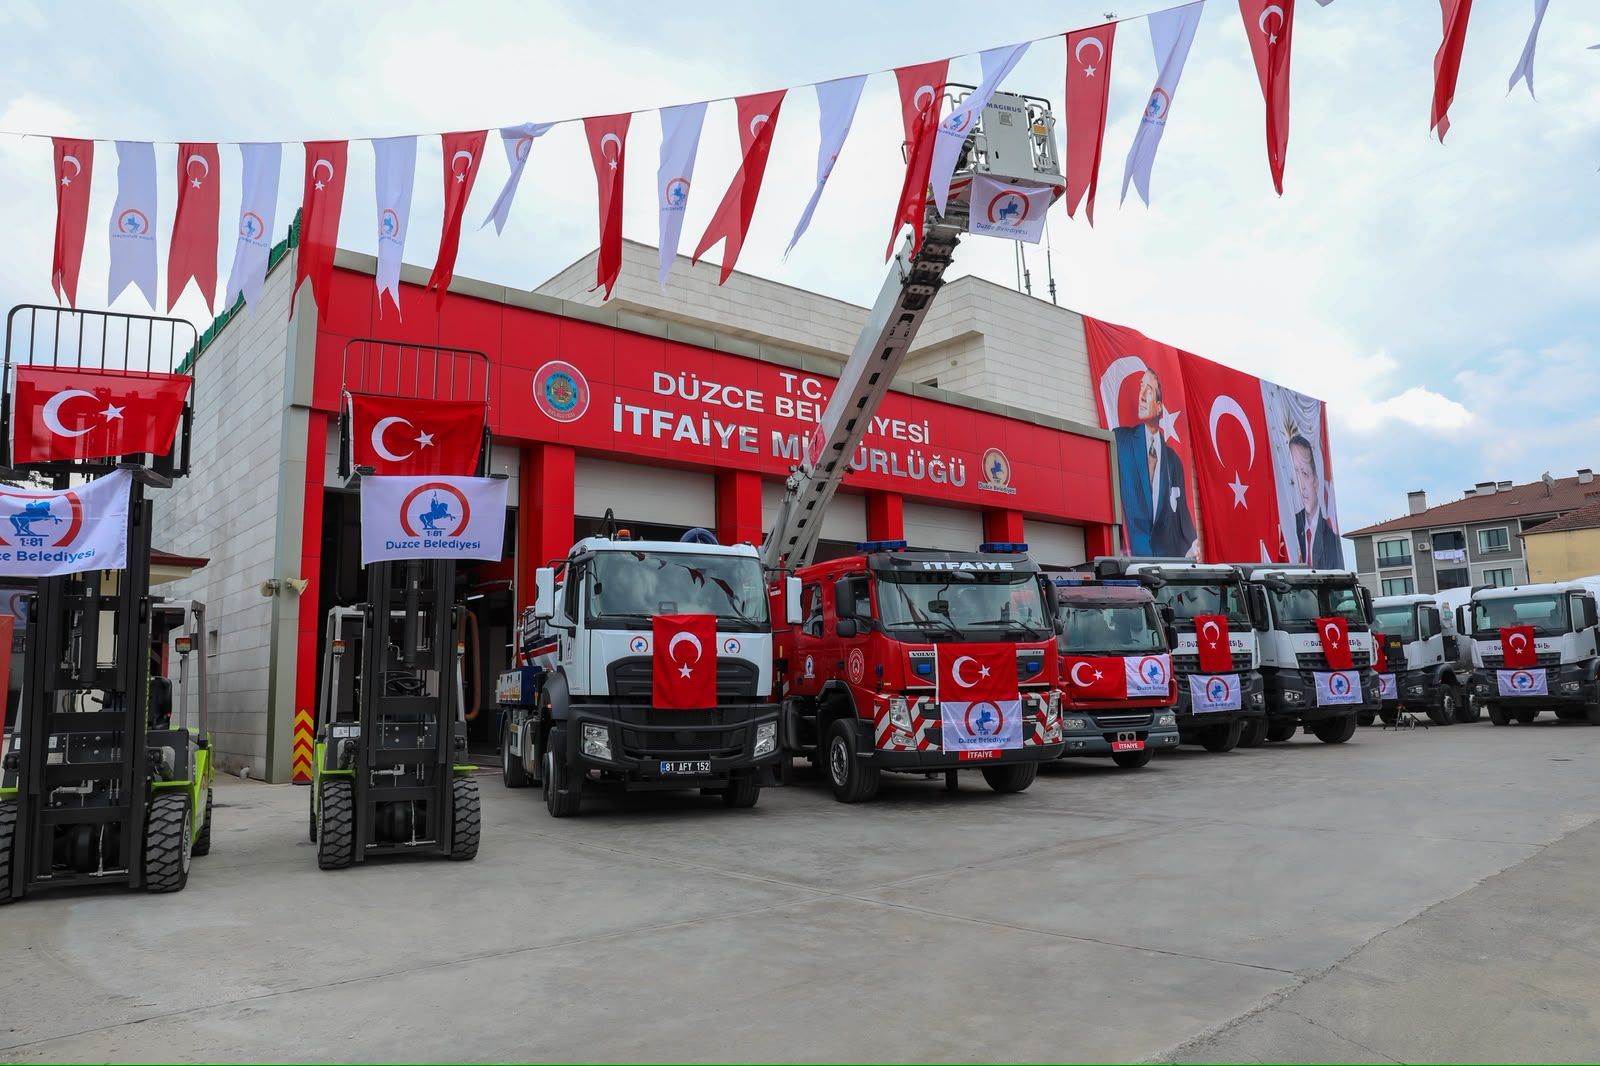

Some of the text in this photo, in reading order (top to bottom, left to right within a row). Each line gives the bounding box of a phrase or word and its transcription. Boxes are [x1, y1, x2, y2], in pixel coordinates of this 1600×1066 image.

[986, 102, 1022, 113] MAGIRUS
[779, 372, 827, 400] T.C.
[653, 371, 929, 444] DÜZCE BELYESİ
[613, 396, 759, 454] İTFAİYE
[20, 538, 43, 547] 1:81
[424, 539, 481, 551] Belediyesi
[17, 549, 95, 563] Belediyesi
[967, 750, 993, 759] İTFAİYE
[665, 762, 709, 771] 81 AFY 152
